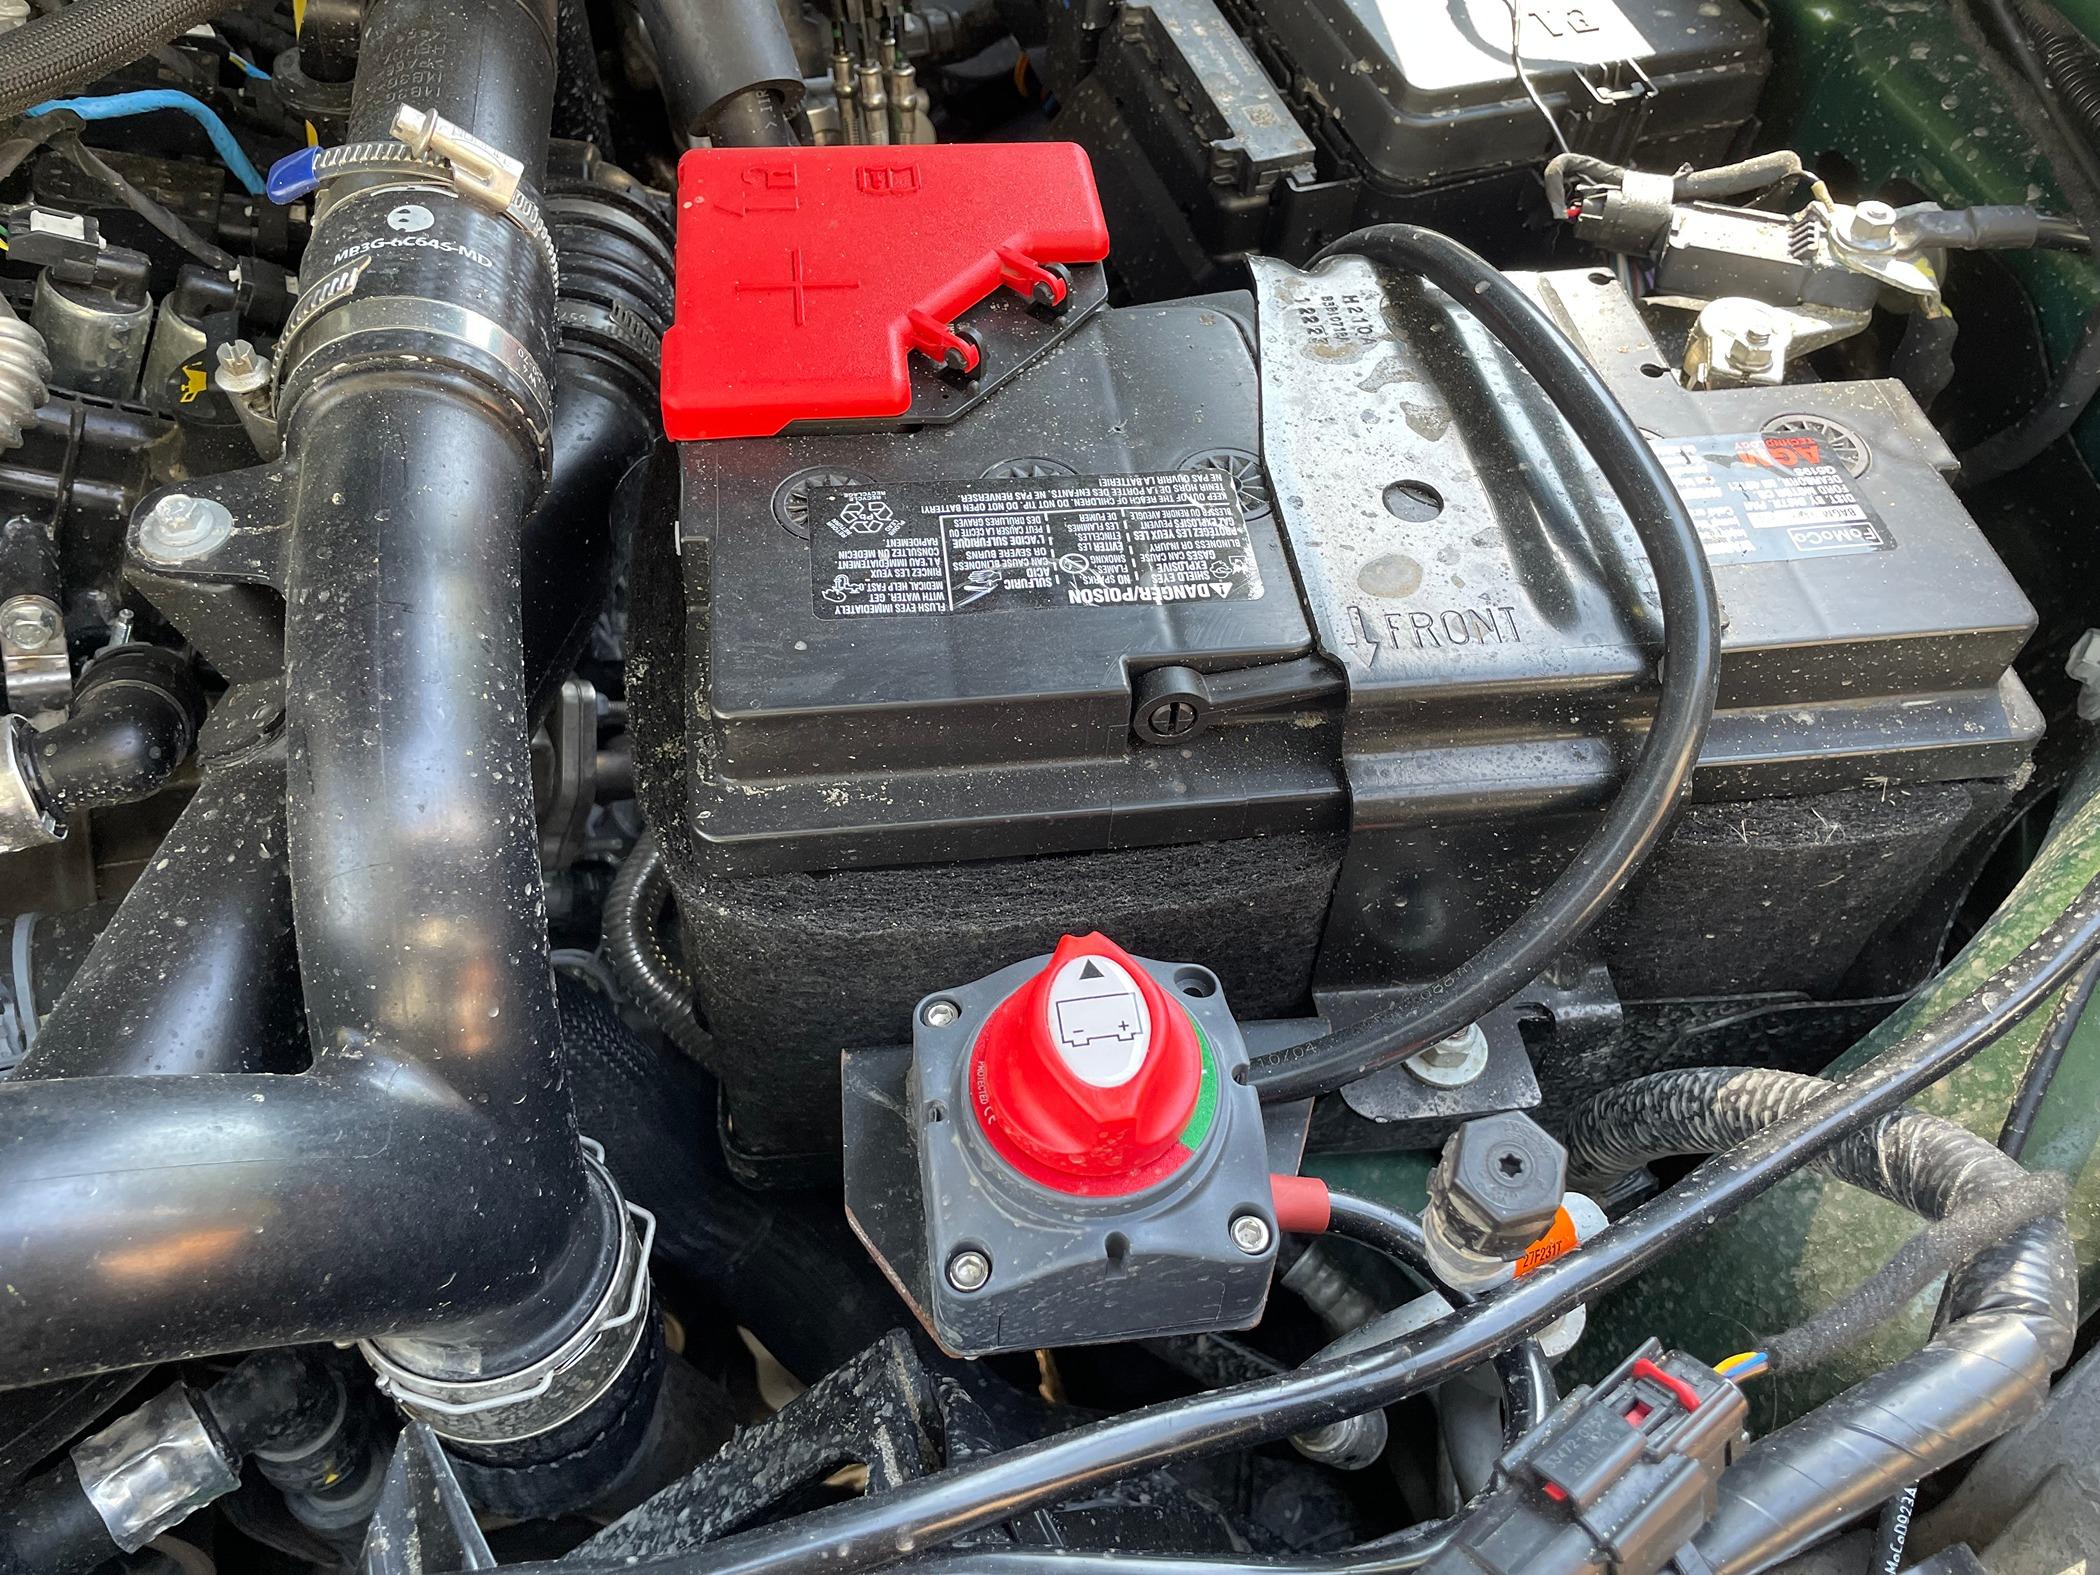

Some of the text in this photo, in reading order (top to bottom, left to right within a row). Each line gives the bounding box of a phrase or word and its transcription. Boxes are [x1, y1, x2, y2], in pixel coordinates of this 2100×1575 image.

[1737, 447, 1821, 467] AGM
[1144, 476, 1156, 485] LA
[1157, 475, 1190, 484] OUVRIR
[1191, 474, 1209, 482] PAS
[1209, 473, 1222, 482] NE
[958, 482, 1225, 503] TENIR HORS DE LA PORTÉE DES ENFANTS. NE PAS RENVERSER.
[1817, 484, 1851, 494] FORD
[1115, 496, 1127, 505] OF
[1129, 494, 1157, 504] REACH
[1158, 493, 1174, 502] THE
[1176, 493, 1187, 502] OF
[1207, 491, 1228, 501] KEEP
[987, 502, 1005, 511] NOT
[1006, 501, 1019, 511] DO
[1020, 500, 1037, 510] TIP.
[1038, 500, 1055, 509] NOT
[1056, 499, 1070, 508] DO
[1071, 497, 1115, 507] CHILDREN.
[920, 504, 961, 514] BATTERY!
[963, 503, 986, 512] OPEN
[1190, 508, 1200, 517] OU
[1079, 512, 1117, 522] DE FUMER
[1130, 510, 1160, 520] AVEUGLE
[1162, 509, 1189, 518] RENDRE
[953, 518, 984, 528] GRAVES
[1026, 515, 1041, 525] DES
[1141, 519, 1173, 529] PEUVENT
[985, 527, 995, 536] LA
[995, 526, 1024, 536] CAUSER
[1024, 525, 1043, 534] PEUT
[1064, 522, 1119, 533] LES FLAMMES,
[948, 529, 960, 538] OU
[1133, 527, 1238, 540] PROTÉGEZ LES YEUX LES
[1793, 528, 1877, 544] FoMoCo
[882, 538, 939, 548] RAPIDEMENT.
[952, 535, 1045, 549] L'ACIDE SULFURIQUE
[1077, 541, 1124, 553] ÉVITER LES
[1149, 540, 1241, 552] BLINDNESS OR INJURY
[838, 547, 940, 561] CONSULTEZ UN MÉDECIN
[965, 547, 1047, 560] OR SEVERE BURNS
[1140, 550, 1216, 562] GASES CAN CAUSE
[910, 557, 934, 568] L'EAU
[952, 557, 1048, 571] CAN CAUSE BLINDNESS
[1090, 554, 1126, 564] SMOKING
[1094, 564, 1128, 573] FLAMES,
[1156, 560, 1207, 572] EXPLOSIVE
[870, 567, 943, 578] RINCEZ LES YEUX
[1026, 567, 1050, 578] ACID
[1151, 571, 1210, 584] SHIELD EYES
[1004, 577, 1053, 590] SULFURIC
[1080, 574, 1131, 585] NO SPARKS,
[887, 582, 908, 591] HELP
[908, 581, 944, 591] MEDICAL
[869, 592, 945, 603] WITH WATER. GET
[1068, 583, 1210, 605] DANGER/POISON
[834, 603, 946, 615] FLUSH EYES IMMEDIATELY
[1384, 606, 1521, 650] FRONT
[976, 1060, 989, 1105] PROTECTED
[1522, 1240, 1562, 1268] 27F231T
